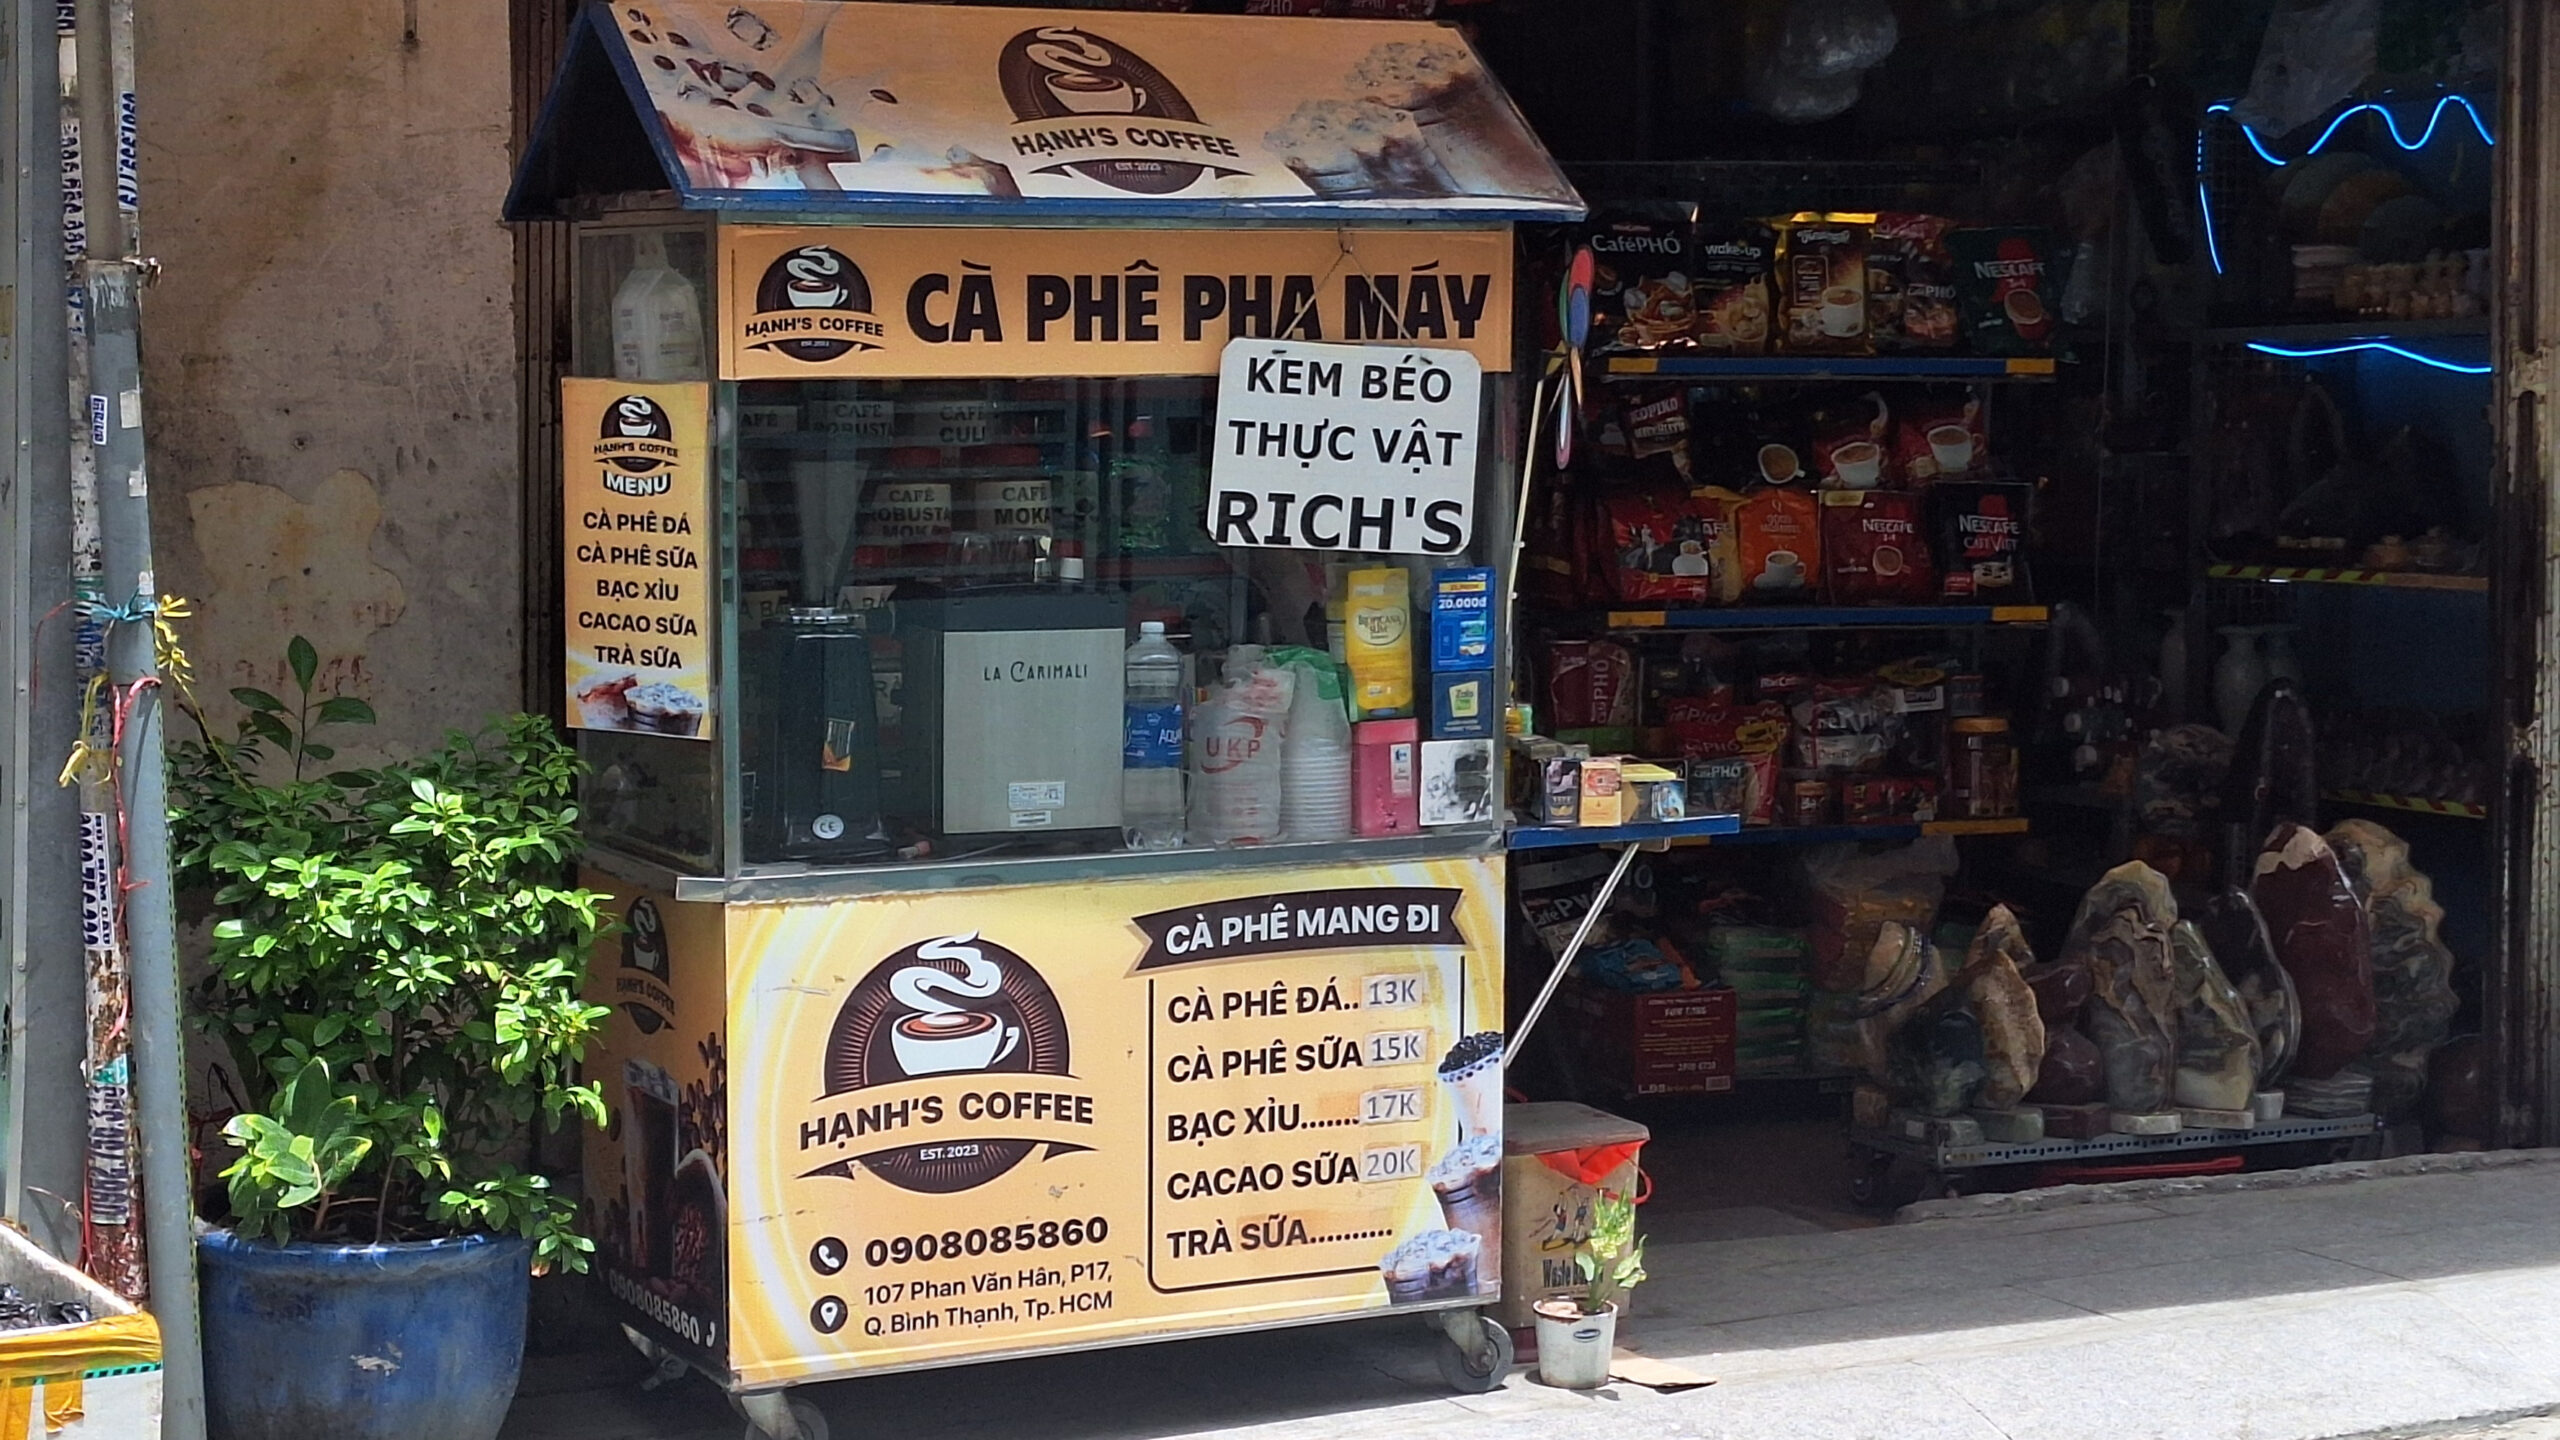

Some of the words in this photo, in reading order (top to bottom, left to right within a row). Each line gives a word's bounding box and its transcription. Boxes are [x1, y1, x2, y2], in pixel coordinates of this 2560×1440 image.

[1012, 128, 1118, 157] HẠNH'S
[1125, 128, 1240, 157] COFFEE
[906, 259, 1002, 343] CÀ
[1027, 259, 1159, 342] PHÊ
[1184, 274, 1324, 341] PHA
[1344, 260, 1490, 339] MÁY
[745, 317, 812, 338] HẠNH'S
[819, 317, 883, 337] COFFEE
[1360, 354, 1452, 403] BÉO
[638, 443, 679, 458] COFFEE
[1228, 418, 1355, 469] THỰC
[1373, 418, 1463, 474] VẬT
[603, 470, 671, 497] MENU
[889, 488, 935, 503] CAFÉ
[583, 507, 612, 530] CÀ
[617, 510, 657, 533] PHÊ
[662, 512, 691, 535] ĐÁ
[1215, 490, 1463, 553] RICH'S
[577, 540, 606, 564] CÀ
[611, 543, 651, 566] PHÊ
[656, 546, 698, 569] SỮA
[597, 579, 639, 603] BẠC
[578, 611, 650, 634] CACAO
[655, 613, 698, 637] SỮA
[594, 642, 635, 666] TRÀ
[640, 645, 682, 669] SỮA
[984, 666, 1002, 681] LA
[1165, 914, 1213, 955] CÀ
[1222, 902, 1288, 944] PHÊ
[1299, 905, 1399, 937] MANG
[1406, 904, 1440, 933] ĐI
[1168, 987, 1213, 1023] CÀ
[1223, 980, 1287, 1019] PHÊ
[1368, 978, 1417, 1006] 13K
[1168, 1046, 1213, 1083] CÀ
[1222, 1039, 1287, 1078] PHÊ
[1295, 1036, 1362, 1072] SỮA
[1371, 1035, 1419, 1062] 15K
[1367, 1092, 1415, 1120] 17K
[800, 1095, 943, 1151] HẠNH'S
[958, 1091, 1093, 1125] COFFEE
[1167, 1109, 1235, 1147] BẠC
[919, 1147, 945, 1161] EST.
[947, 1144, 979, 1159] 2023
[1366, 1148, 1416, 1177] 20K
[1167, 1163, 1284, 1201] CACAO
[1291, 1151, 1359, 1187] SỮA
[864, 1215, 1108, 1268] 0908085860
[1166, 1219, 1232, 1259] TRÀ
[864, 1284, 904, 1307] 107
[911, 1277, 965, 1301] Phan
[971, 1270, 1012, 1294] Văn
[1017, 1263, 1067, 1291] Hân,
[1070, 1260, 1113, 1285] P17,
[608, 1267, 700, 1345] 0908085860
[864, 1317, 886, 1337] Q.
[891, 1310, 939, 1334] Bình
[945, 1303, 1020, 1330] Thạnh,
[1024, 1297, 1056, 1320] Tp.
[1059, 1291, 1112, 1312] HCM
